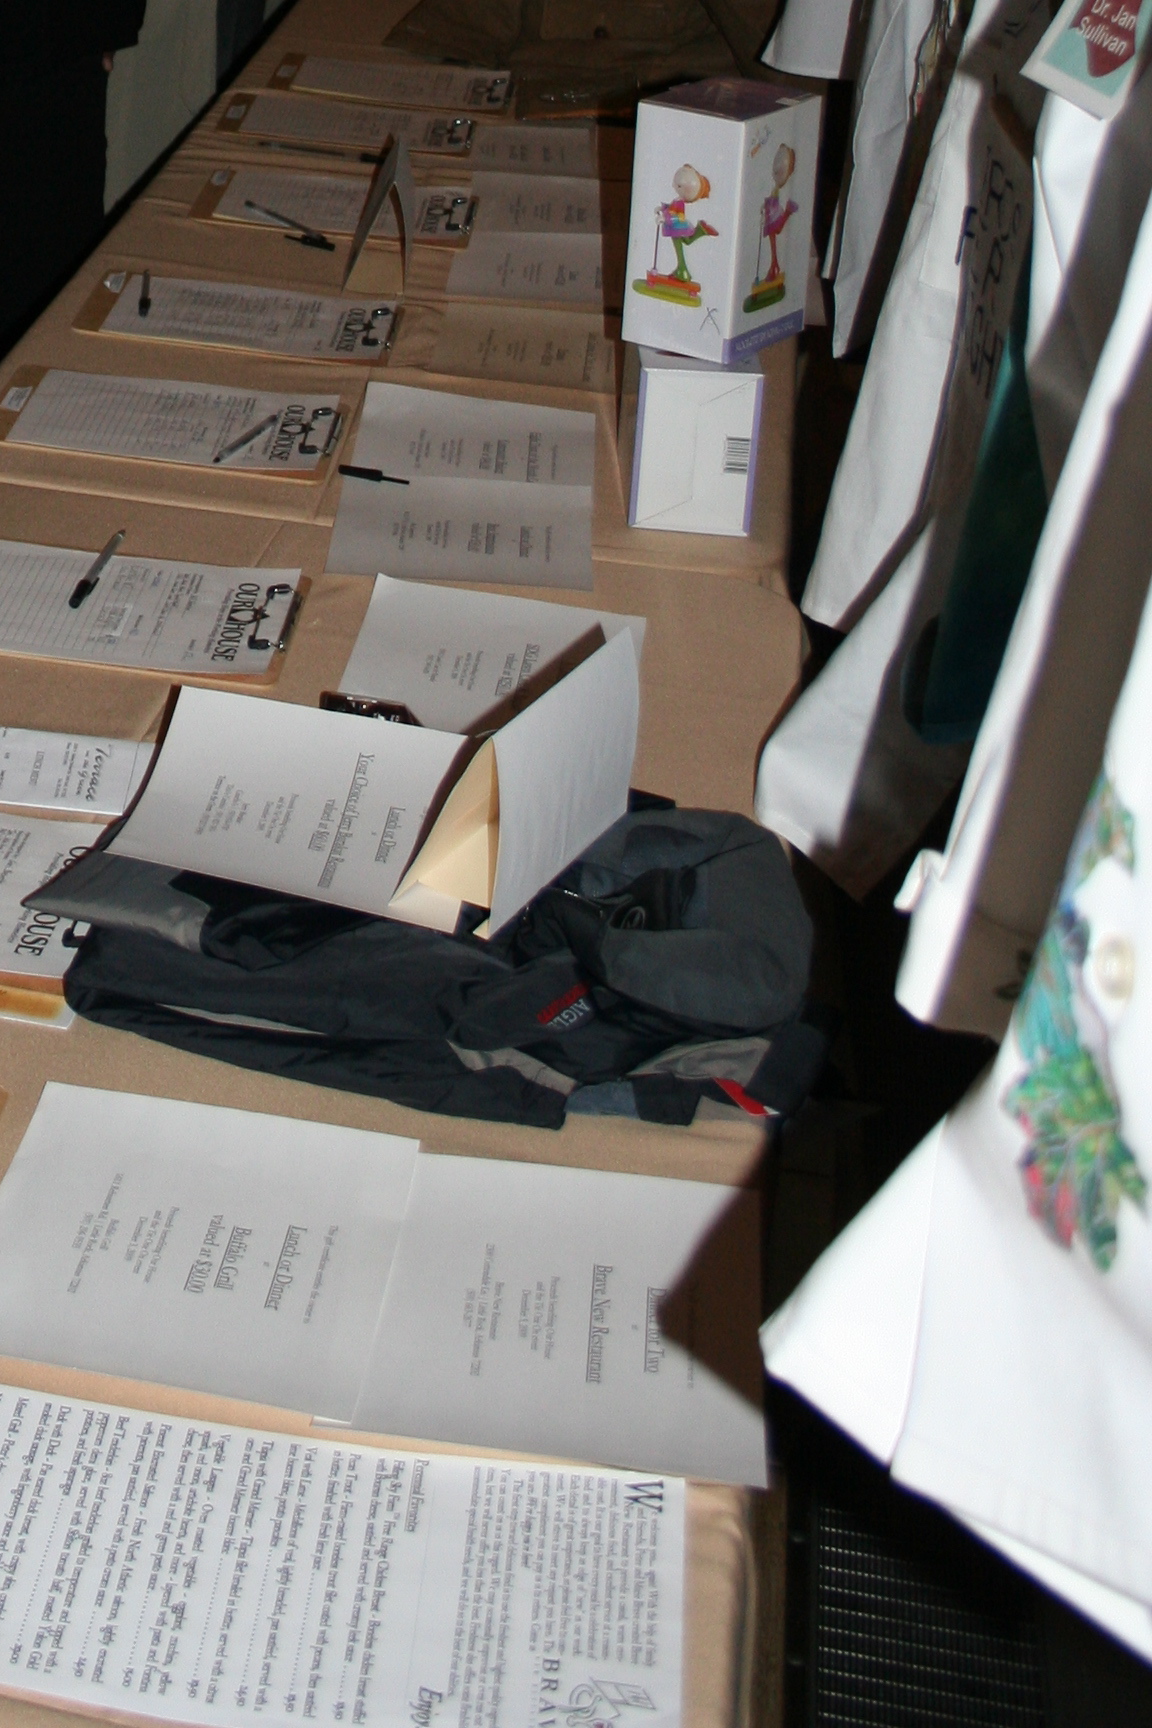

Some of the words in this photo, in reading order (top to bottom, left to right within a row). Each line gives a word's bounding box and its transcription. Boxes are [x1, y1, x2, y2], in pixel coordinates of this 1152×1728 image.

[1111, 5, 1137, 32] Jan
[1077, 15, 1128, 57] Sullivan
[283, 404, 306, 423] OUR
[268, 433, 296, 461] HOUSE
[232, 582, 260, 608] OUR
[211, 621, 247, 661] HOUSE
[203, 1214, 225, 1247] valued
[222, 1226, 252, 1263] Buffalo
[280, 1224, 307, 1257] Lunch
[198, 1247, 211, 1258] at
[276, 1257, 292, 1272] or
[183, 1259, 212, 1294] $30.00
[213, 1263, 238, 1290] Grill
[264, 1272, 293, 1311] Dinner
[591, 1263, 613, 1295] Brave
[589, 1295, 611, 1323] New
[585, 1324, 609, 1384] Restaurant
[643, 1345, 667, 1374] Two
